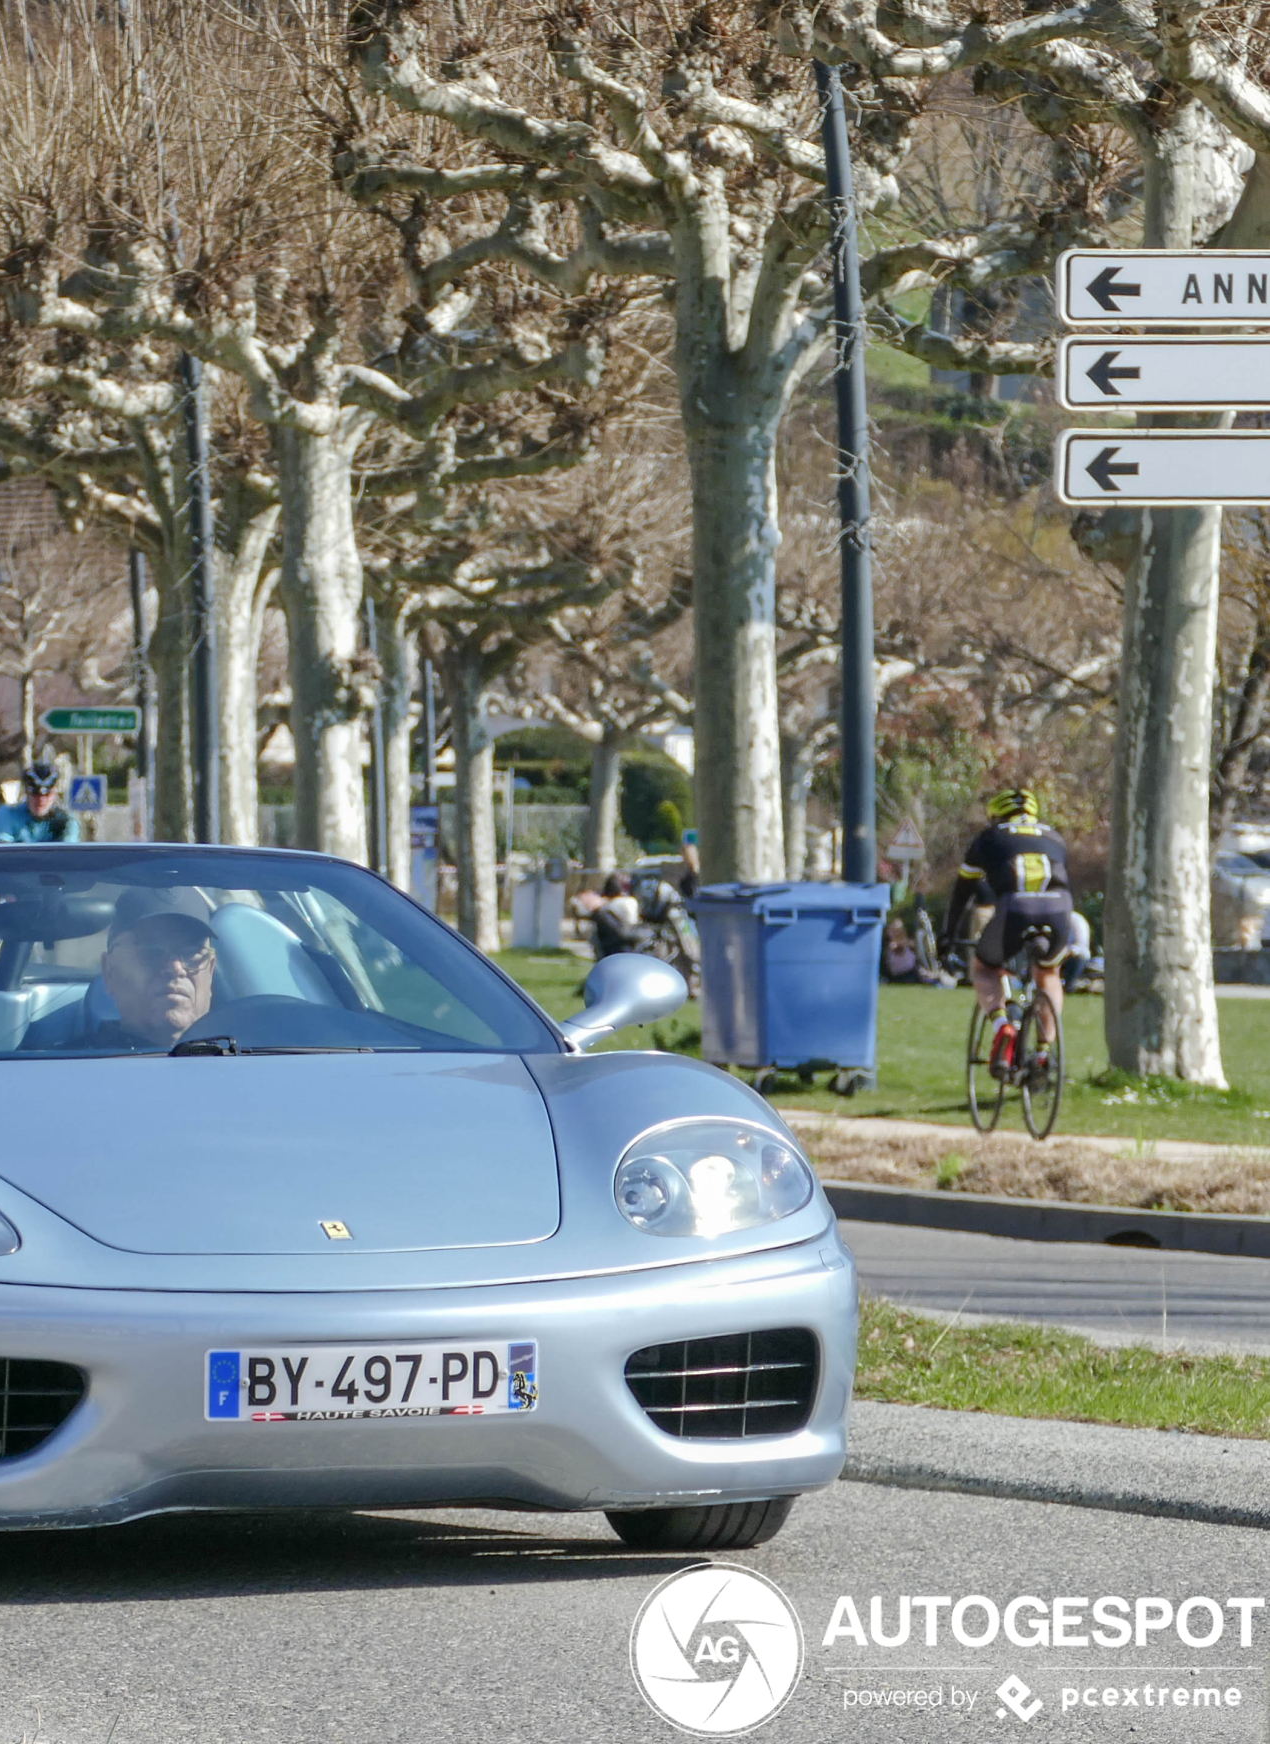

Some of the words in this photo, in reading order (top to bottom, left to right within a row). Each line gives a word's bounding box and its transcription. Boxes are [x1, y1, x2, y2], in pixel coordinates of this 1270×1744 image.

[1181, 272, 1268, 305] ANN
[218, 1390, 229, 1407] F
[246, 1349, 500, 1407] BY-497-PD
[295, 1406, 365, 1421] HAUTE
[368, 1406, 442, 1419] SAVOIE
